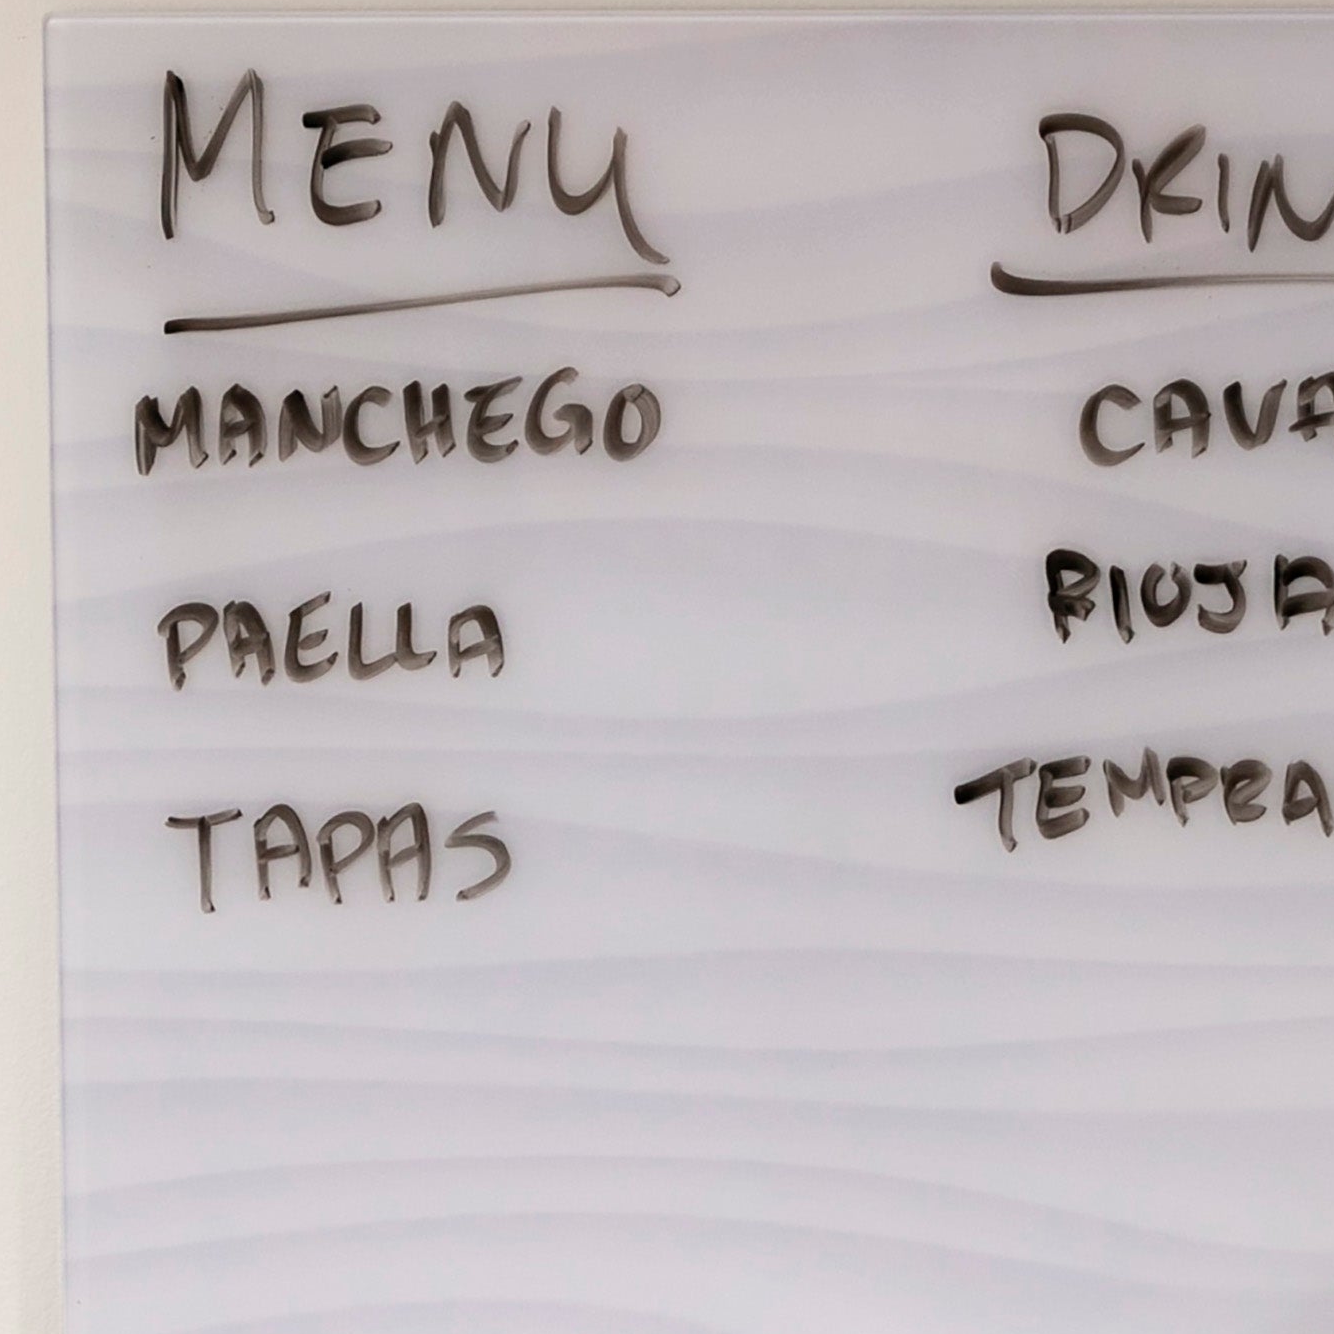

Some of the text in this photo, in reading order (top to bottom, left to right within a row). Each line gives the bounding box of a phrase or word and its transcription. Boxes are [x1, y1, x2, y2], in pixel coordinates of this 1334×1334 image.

[161, 70, 670, 267] MENU
[134, 366, 662, 476] MANCHEGO
[157, 591, 505, 691] PAELLA
[166, 802, 512, 914] TAPAS
